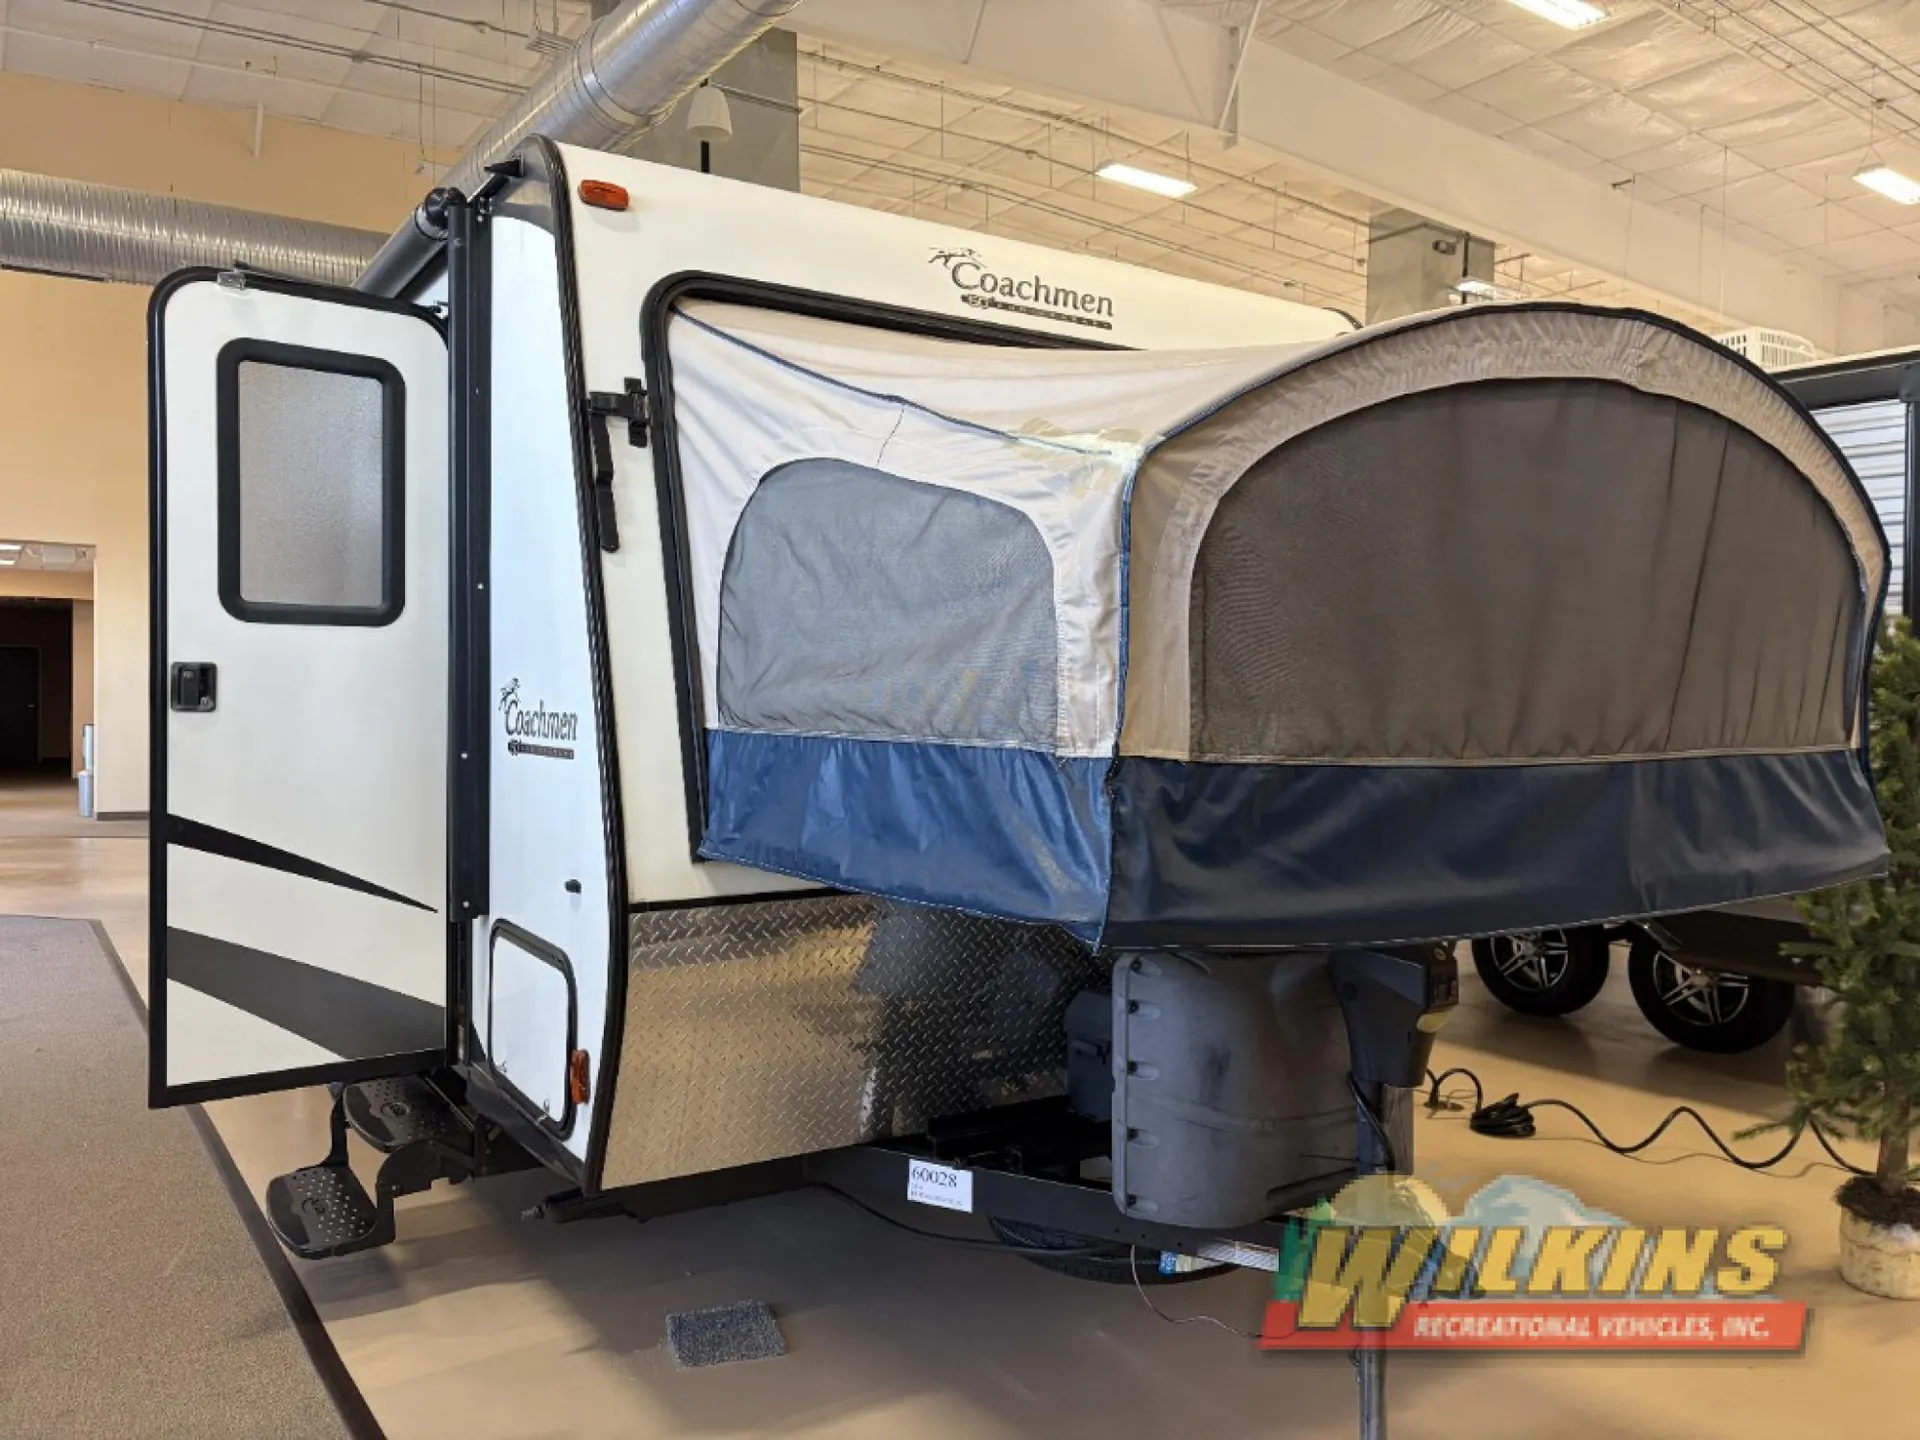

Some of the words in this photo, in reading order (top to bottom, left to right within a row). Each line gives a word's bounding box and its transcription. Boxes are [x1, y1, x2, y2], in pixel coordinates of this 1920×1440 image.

[951, 261, 1113, 317] Coachmen
[505, 698, 578, 741] Coachmen
[911, 1166, 957, 1188] 60028
